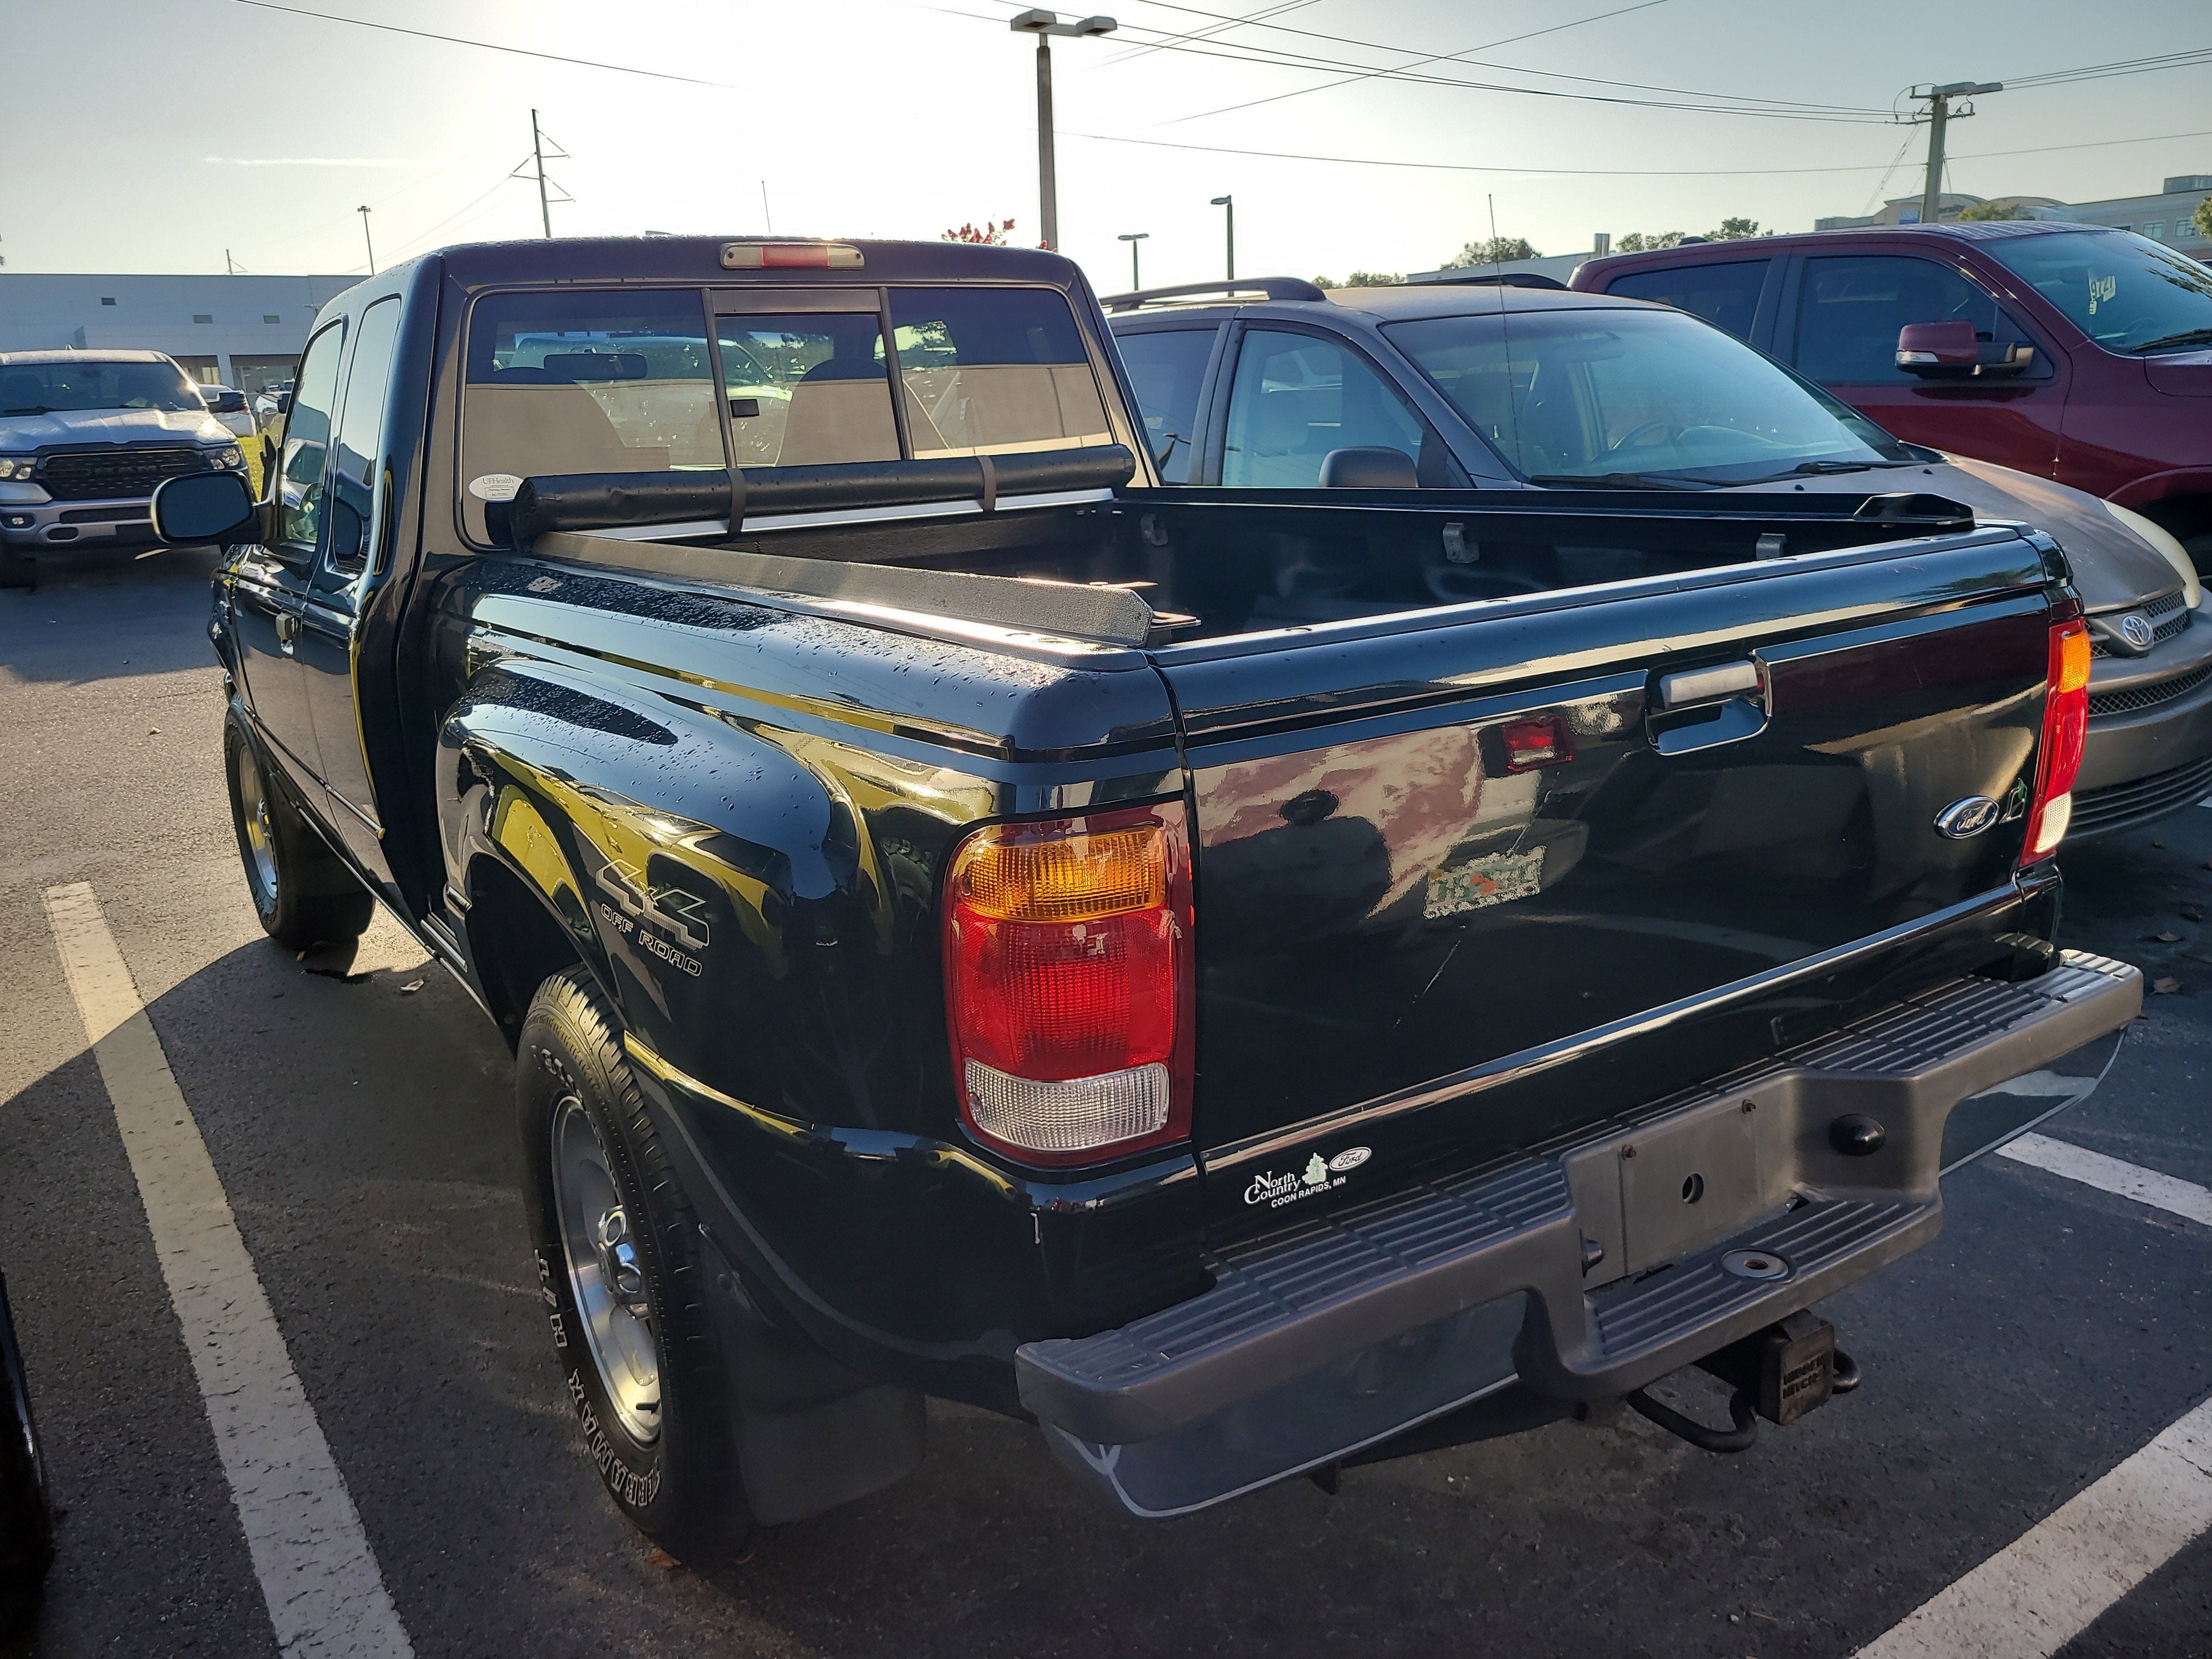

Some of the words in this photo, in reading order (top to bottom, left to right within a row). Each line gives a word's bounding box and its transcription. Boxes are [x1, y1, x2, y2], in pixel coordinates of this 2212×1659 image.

[601, 903, 634, 933] OFF
[638, 929, 702, 977] ROAD
[1244, 1179, 1301, 1205] Country
[1254, 1170, 1295, 1194] North
[1271, 1193, 1297, 1209] COON
[1333, 1175, 1346, 1187] MN
